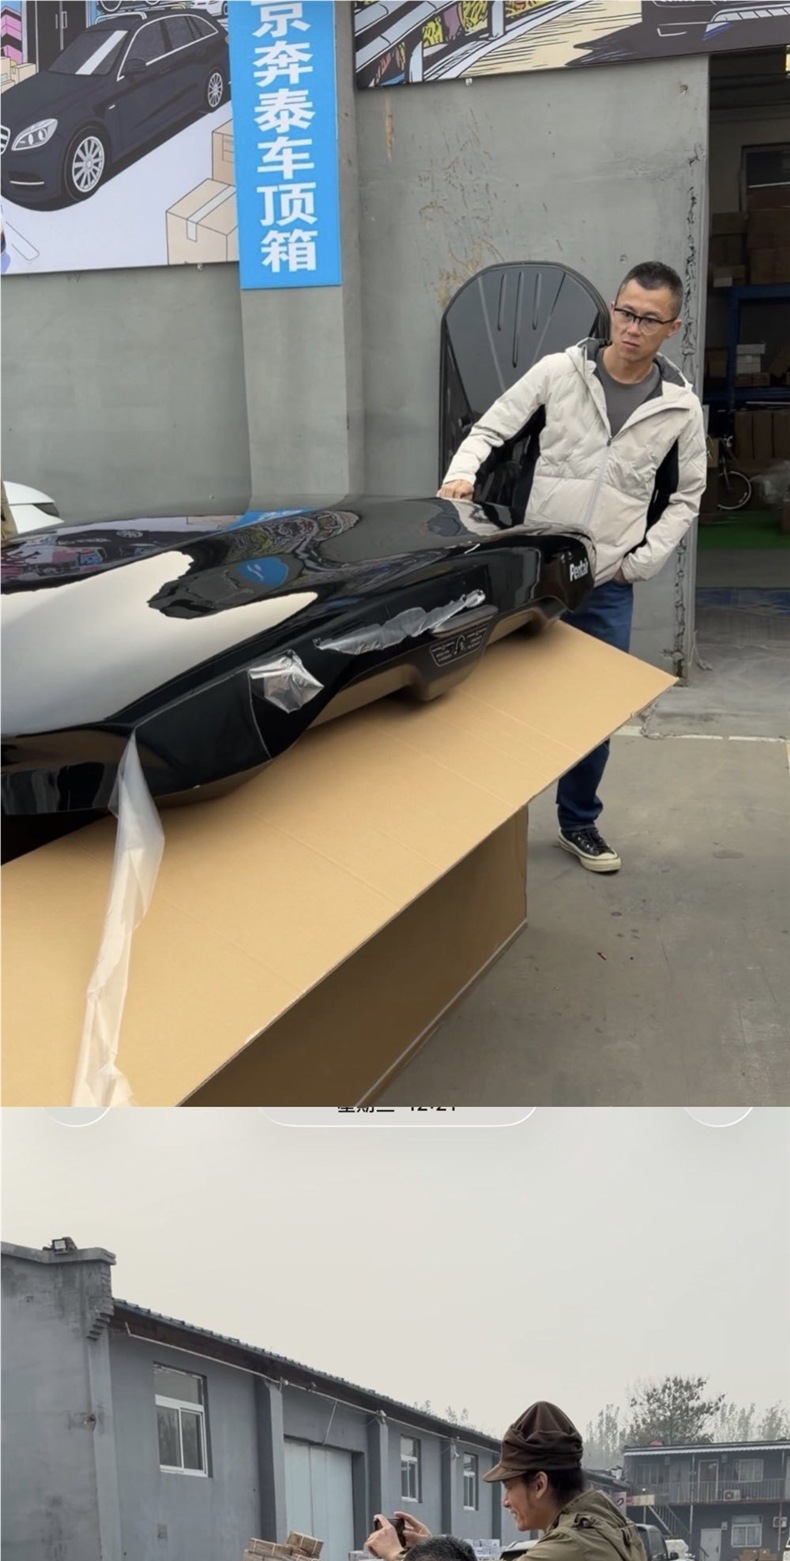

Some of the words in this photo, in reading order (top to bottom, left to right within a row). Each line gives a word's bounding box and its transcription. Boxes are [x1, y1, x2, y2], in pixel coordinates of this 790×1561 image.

[251, 0, 318, 273] 京奔泰车顶箱
